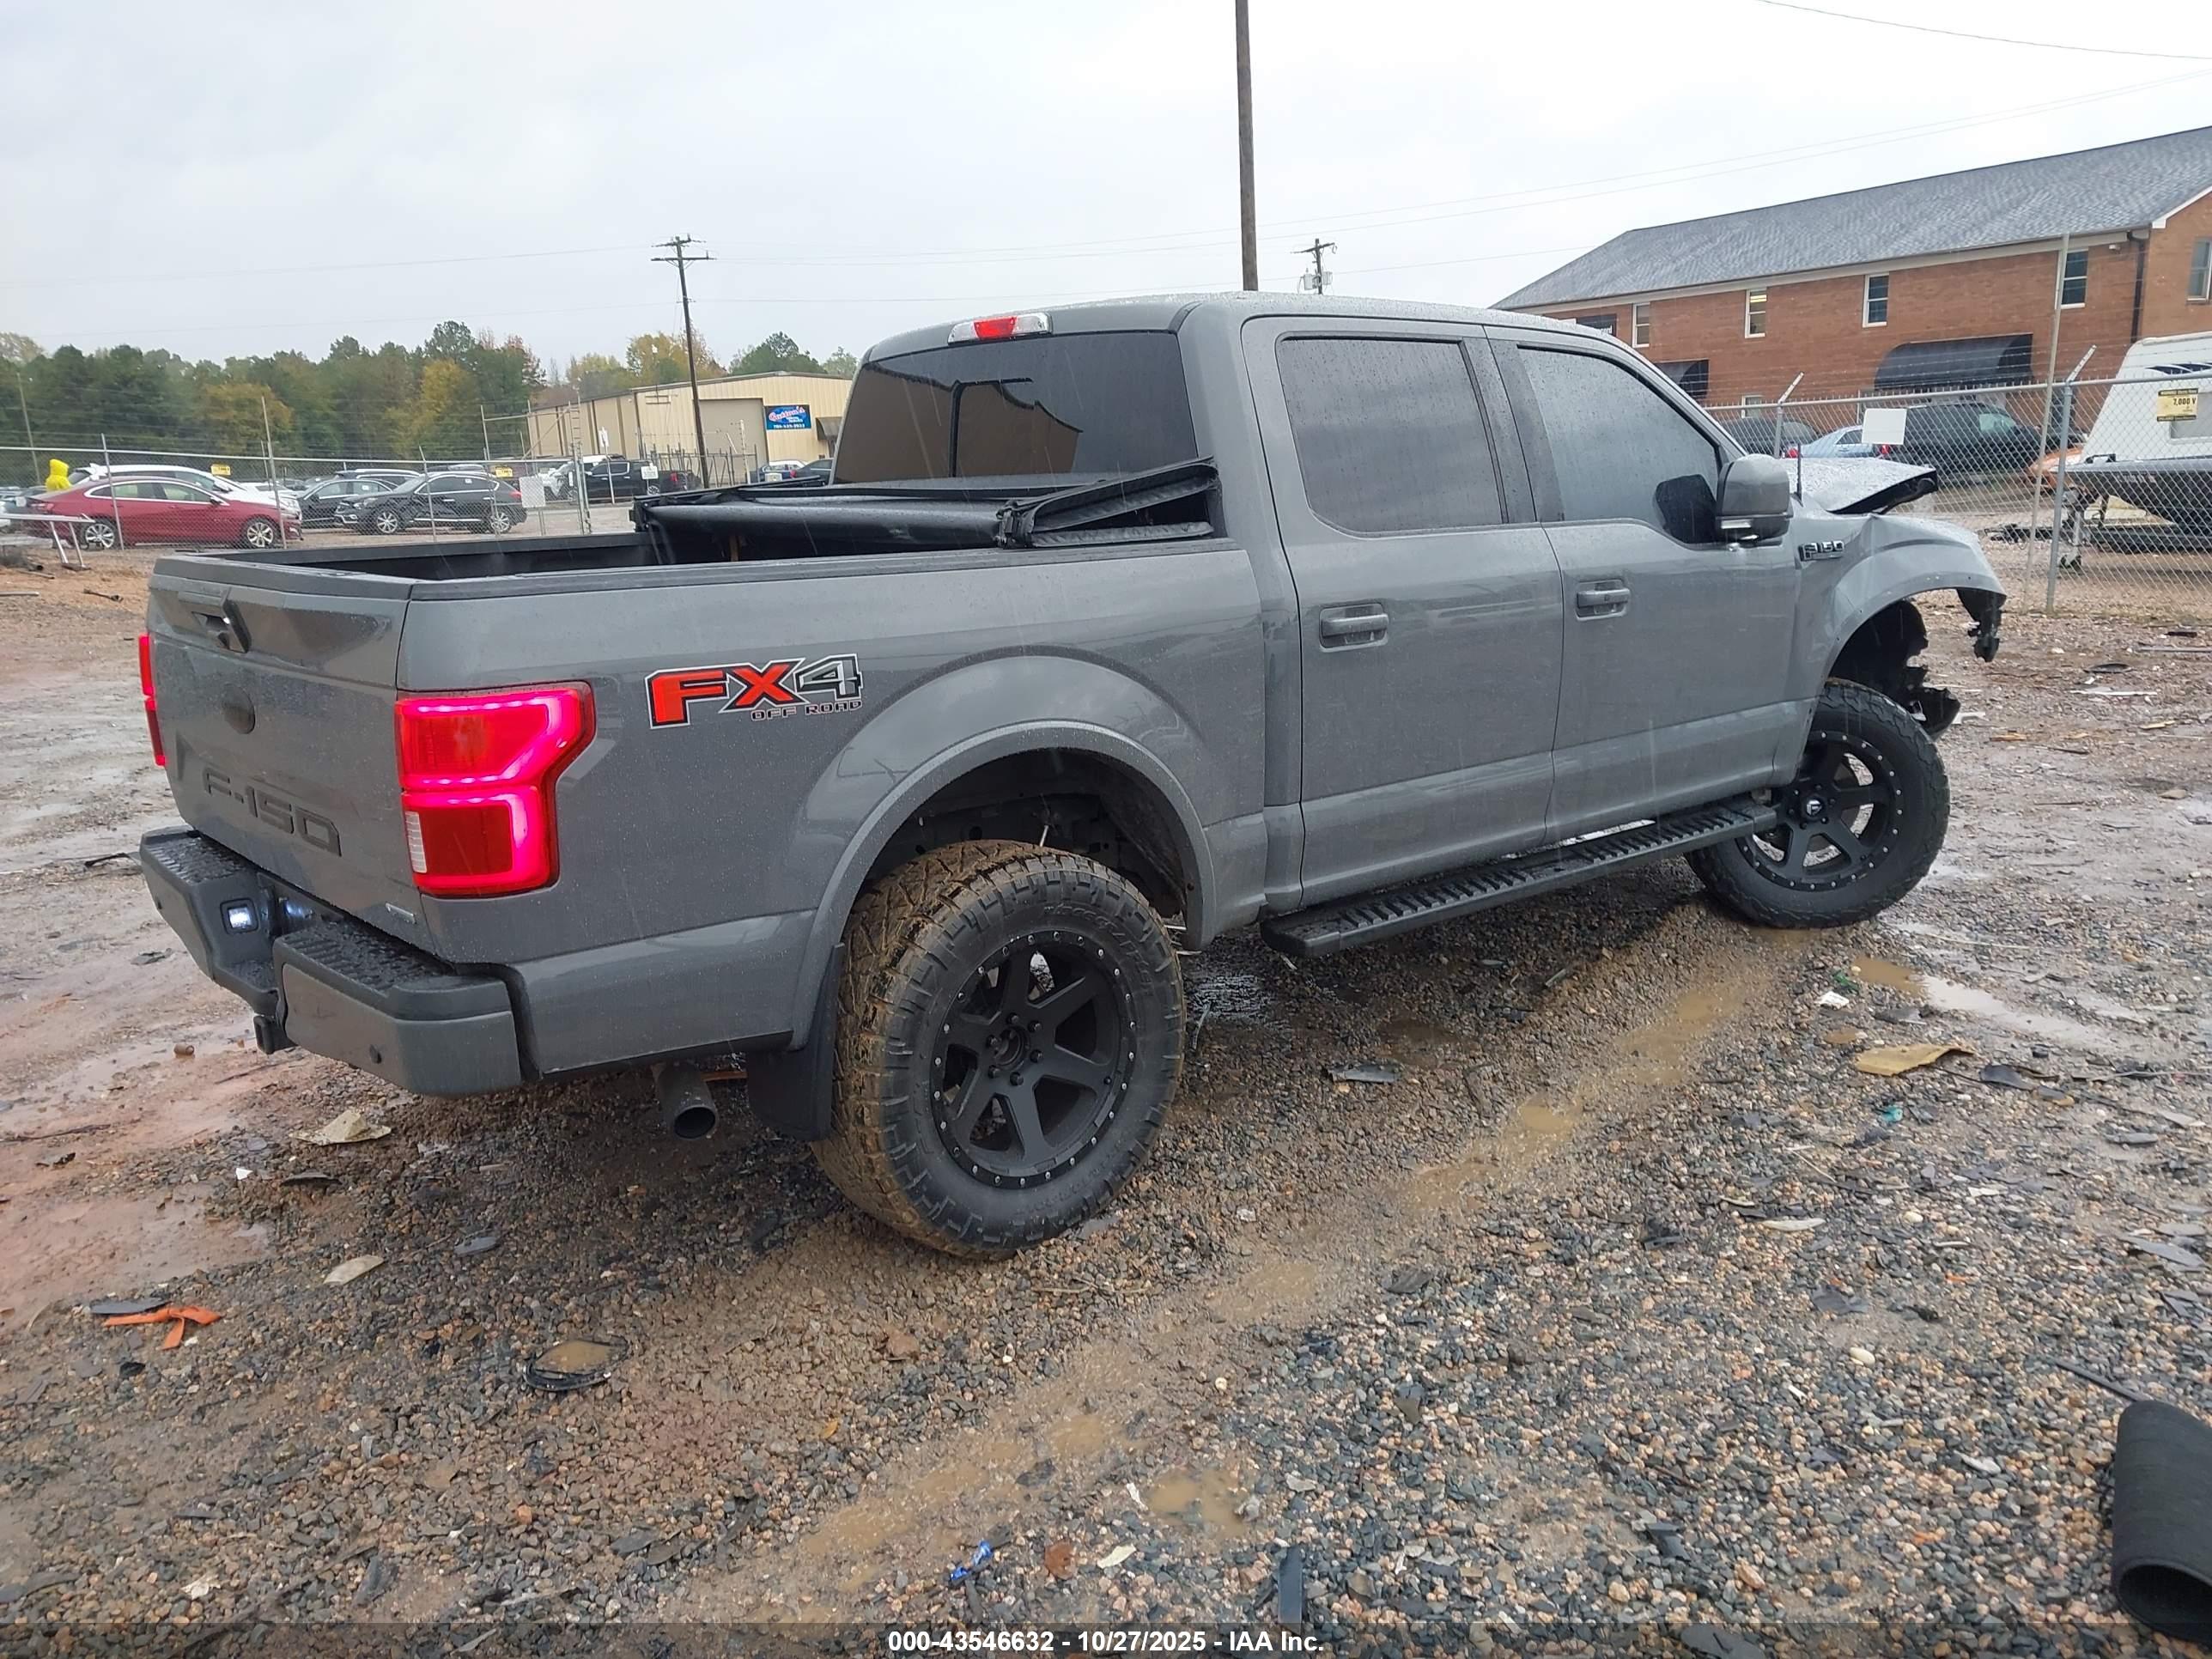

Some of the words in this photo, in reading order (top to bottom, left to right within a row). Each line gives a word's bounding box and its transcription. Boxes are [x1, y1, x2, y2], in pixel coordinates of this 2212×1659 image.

[645, 653, 864, 730] FX4
[750, 707, 798, 722] OFF
[805, 700, 864, 716] ROAD
[203, 767, 342, 858] F-150
